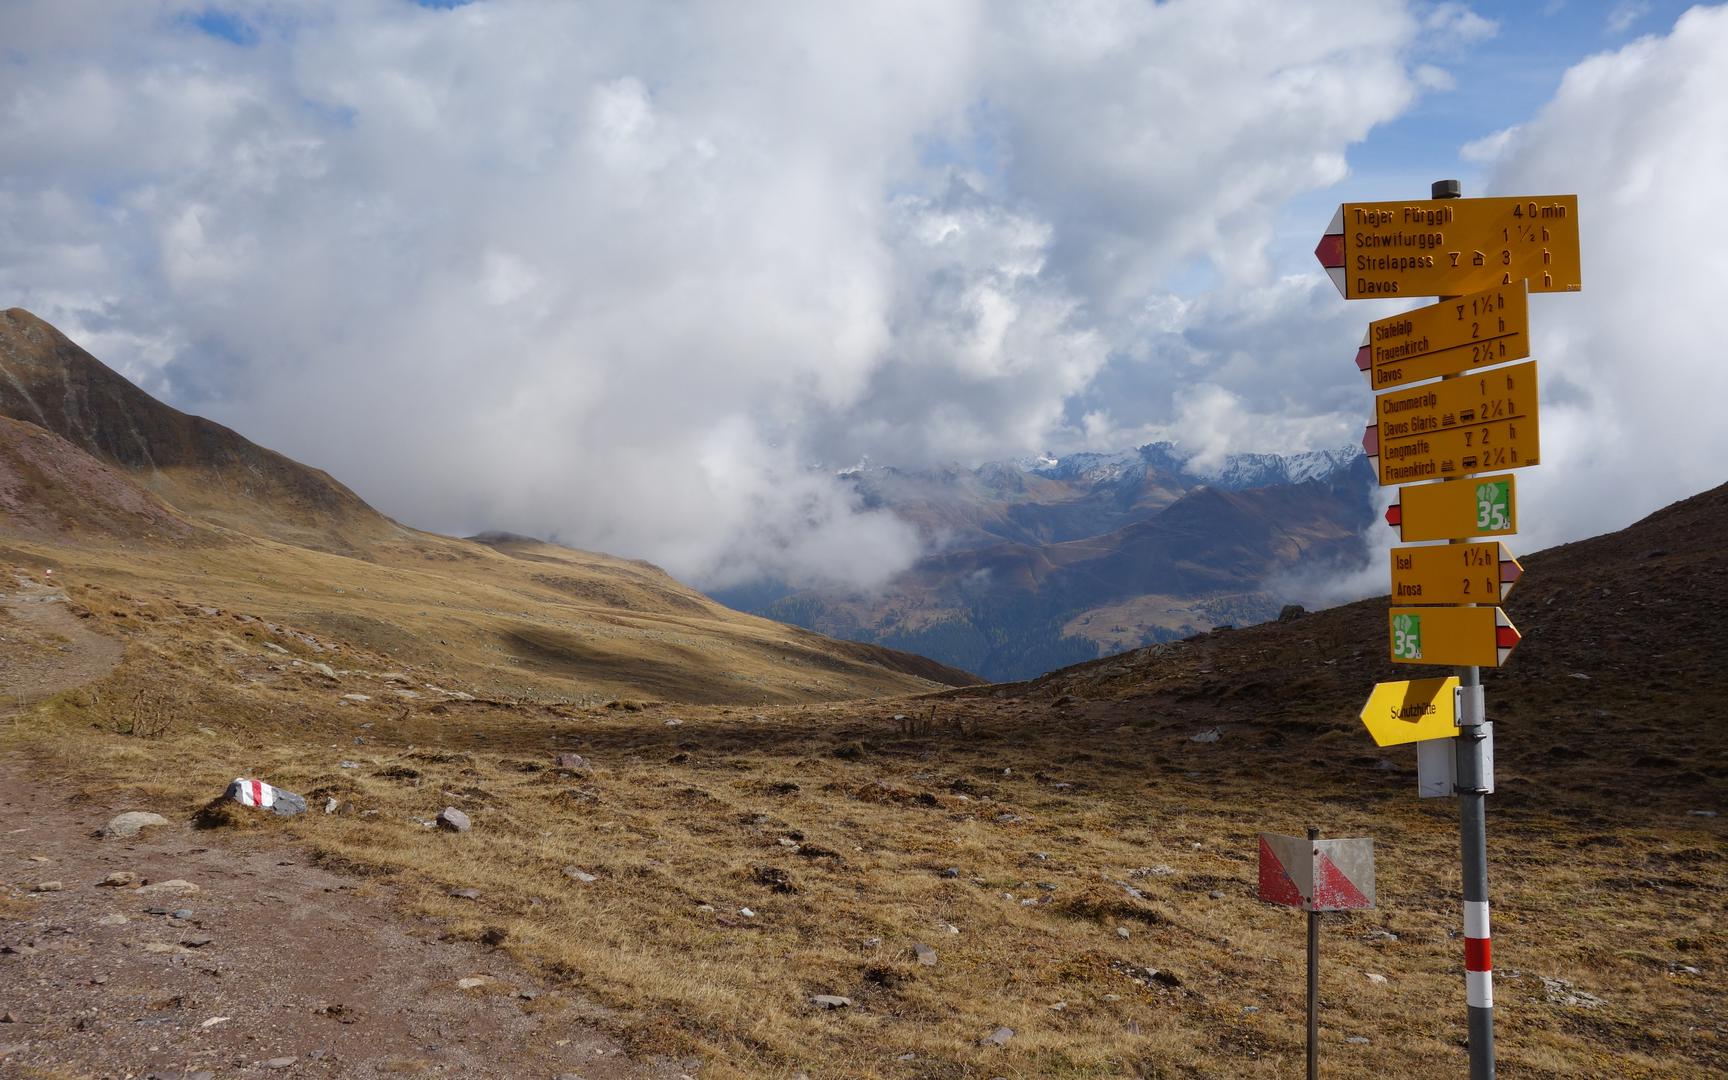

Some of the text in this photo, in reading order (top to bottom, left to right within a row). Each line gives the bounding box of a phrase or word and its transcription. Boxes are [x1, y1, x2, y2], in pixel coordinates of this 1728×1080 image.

[1354, 207, 1394, 228] Tiejer
[1404, 205, 1453, 226] Fürggli
[1541, 202, 1566, 219] min
[1355, 232, 1443, 249] Schwifurgga
[1542, 224, 1550, 242] h
[1357, 248, 1551, 272] Strelapass 3 h
[1357, 278, 1399, 294] Davos
[1502, 272, 1512, 285] 4
[1544, 271, 1552, 288] h
[1375, 320, 1413, 342] Stafelalp
[1497, 294, 1504, 310] h
[1376, 317, 1505, 363] Frauenkirch 2 h
[1377, 368, 1402, 385] Davos
[1499, 341, 1506, 357] h
[1383, 374, 1513, 414] Chummeralp 1 h
[1384, 422, 1409, 438] Davos
[1411, 415, 1438, 432] Glaris
[1508, 398, 1514, 415] h
[1385, 423, 1516, 462] Lengmatte 2 h
[1385, 459, 1436, 481] Frauenkirch
[1511, 447, 1517, 464] h
[1396, 553, 1412, 570] Isel
[1486, 549, 1492, 566] h
[1397, 578, 1493, 597] Arosa 2 h
